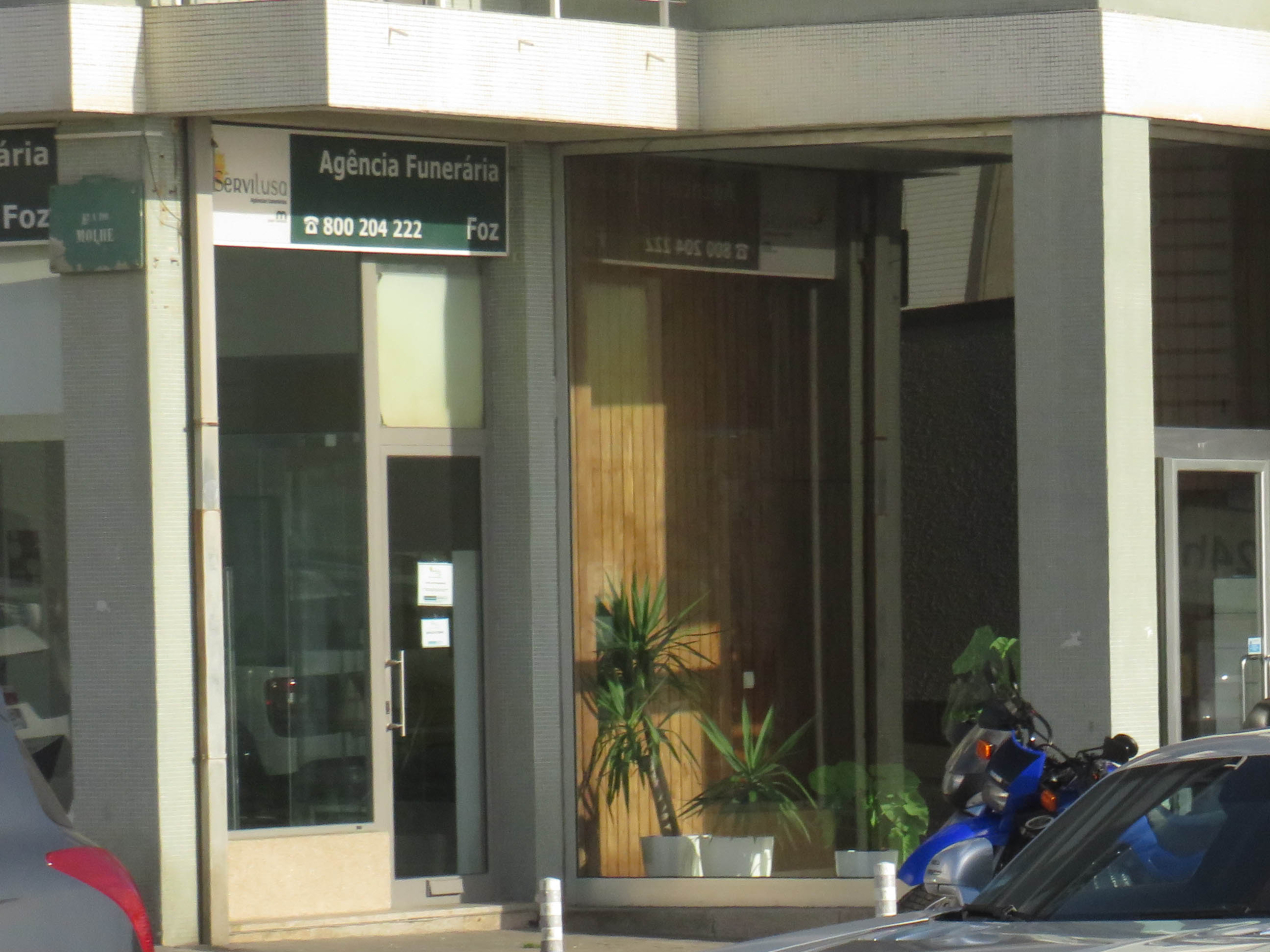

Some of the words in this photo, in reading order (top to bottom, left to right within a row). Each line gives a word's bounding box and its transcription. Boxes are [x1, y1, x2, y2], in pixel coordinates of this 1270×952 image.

[319, 148, 399, 181] Agência
[406, 153, 500, 182] Funerária
[2, 204, 51, 230] Foz
[323, 216, 354, 236] 800
[359, 218, 388, 237] 204
[393, 219, 423, 239] 222
[466, 216, 500, 241] Foz
